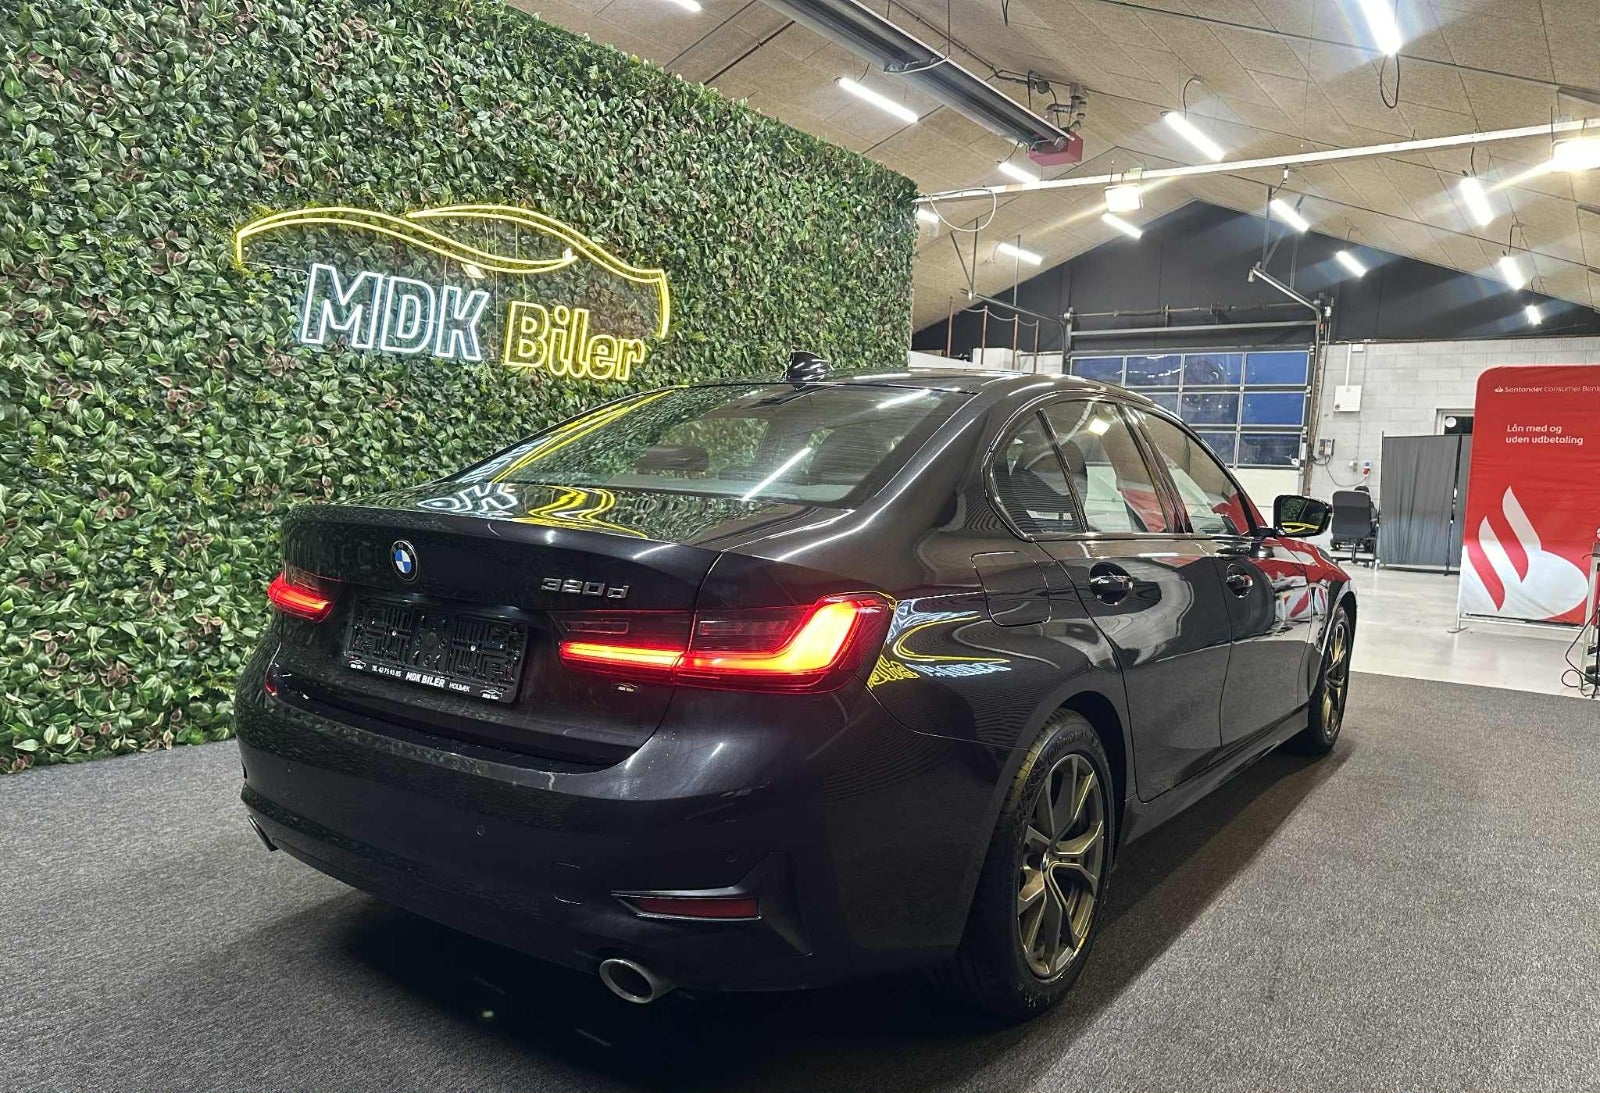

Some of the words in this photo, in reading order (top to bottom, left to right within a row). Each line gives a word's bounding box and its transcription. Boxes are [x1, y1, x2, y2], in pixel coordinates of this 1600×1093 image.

[300, 262, 490, 362] MDK
[503, 300, 646, 382] Biler
[1507, 424, 1524, 432] Lån
[1526, 424, 1547, 432] med
[1549, 425, 1562, 434] og
[1531, 436, 1584, 446] udbetaling
[540, 577, 630, 599] 320d
[405, 671, 422, 682] MDK
[421, 674, 446, 688] BILER
